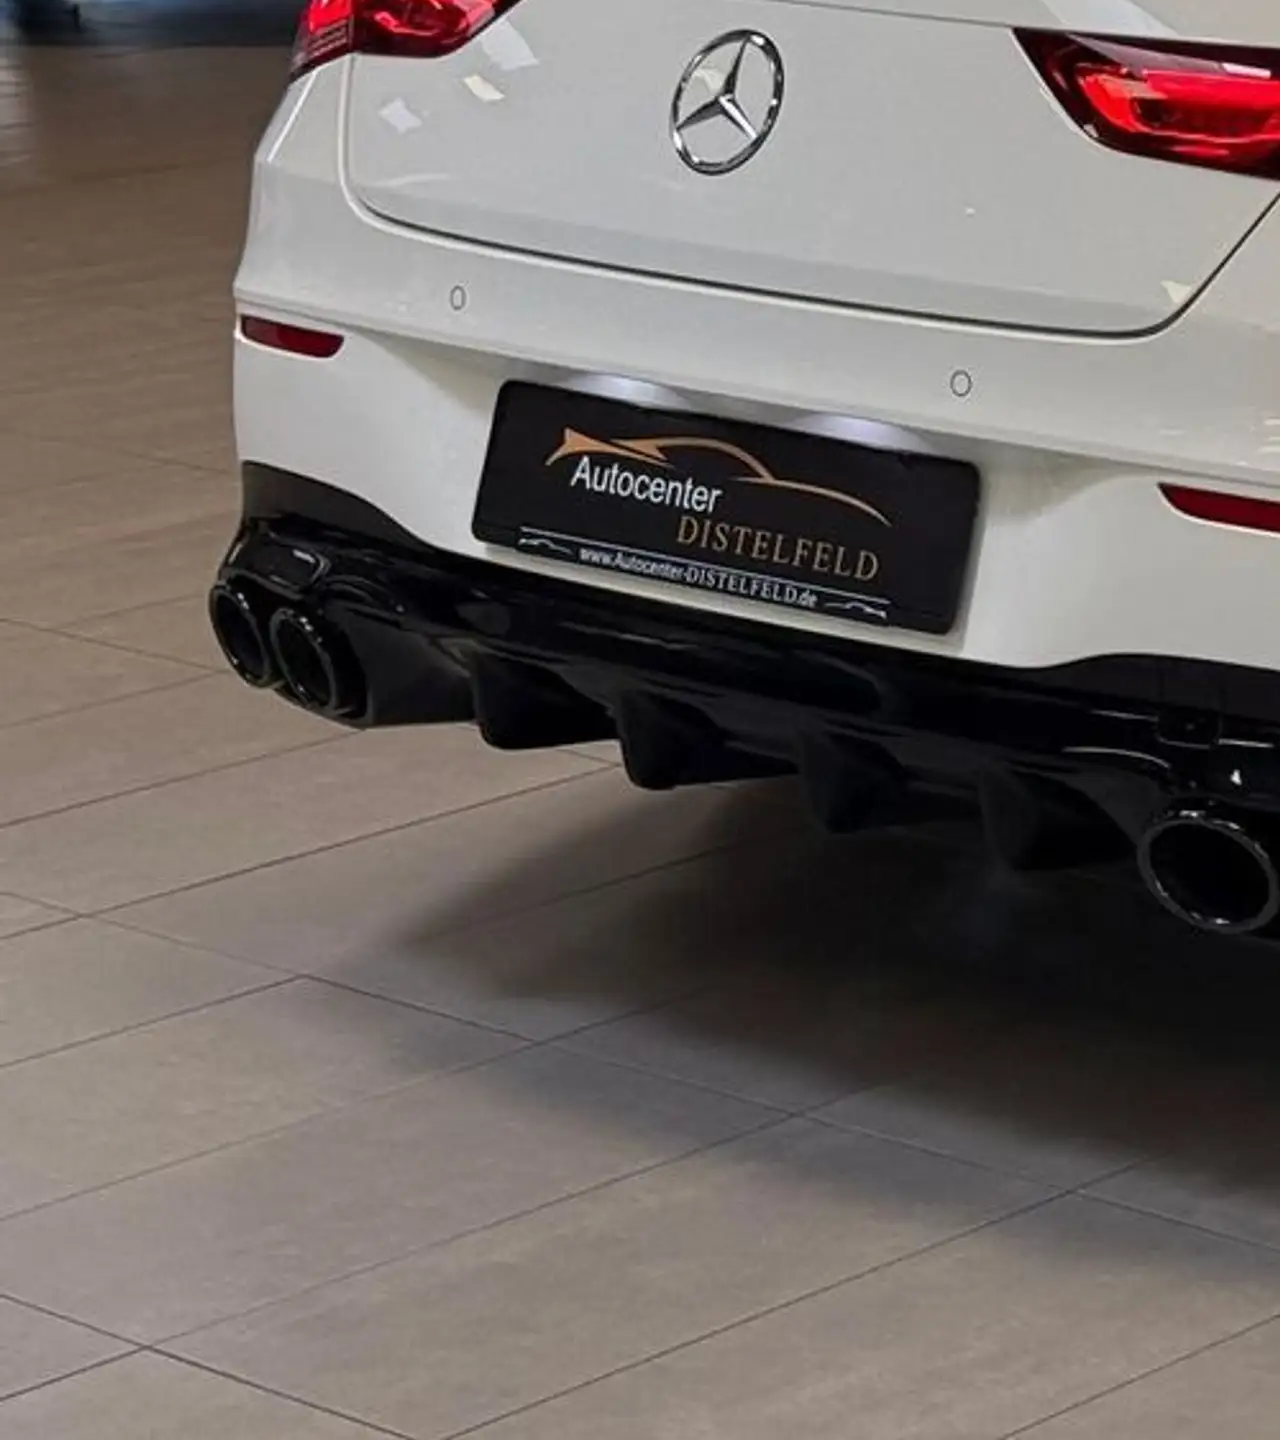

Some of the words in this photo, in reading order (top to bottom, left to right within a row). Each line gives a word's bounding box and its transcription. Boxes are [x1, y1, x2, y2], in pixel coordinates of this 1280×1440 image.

[571, 455, 723, 513] Autocenter
[579, 546, 819, 608] www.Autocenter-DISTELFELD.de
[676, 515, 878, 581] DISTELFELD
